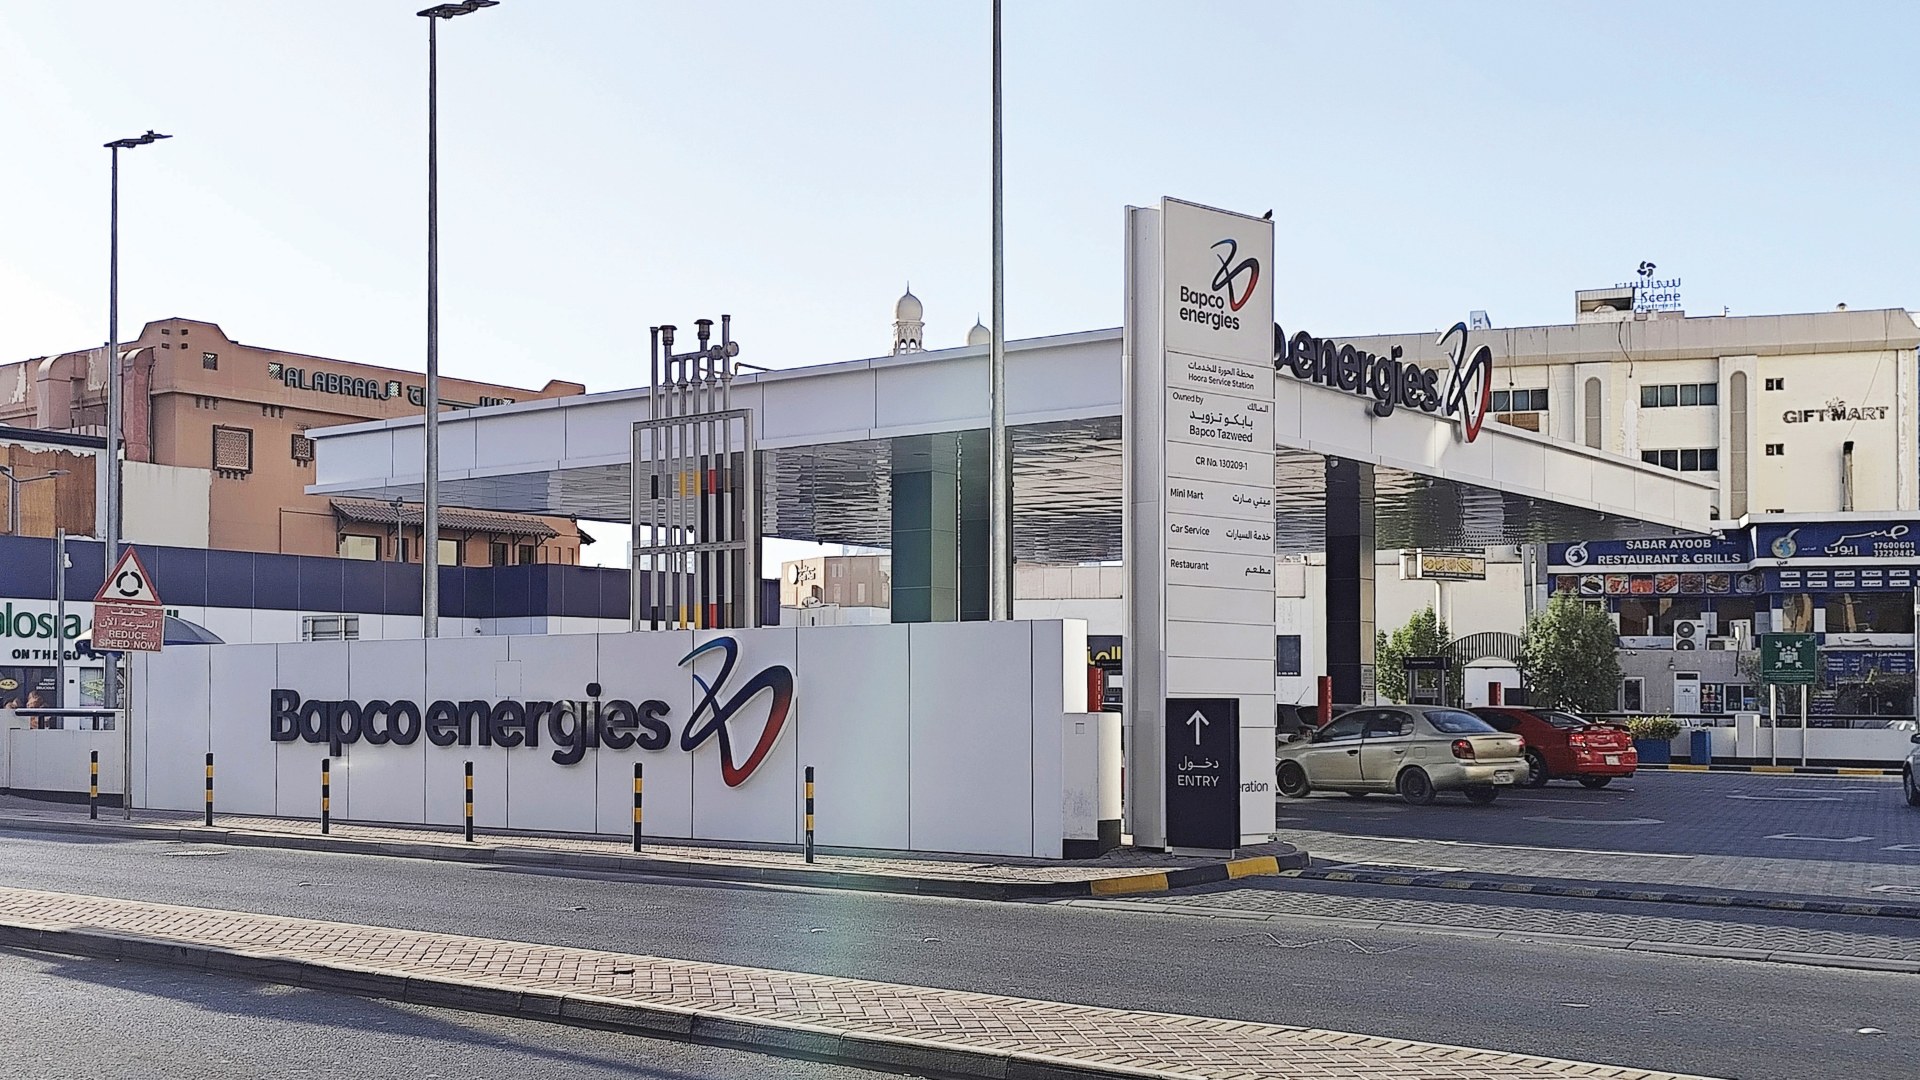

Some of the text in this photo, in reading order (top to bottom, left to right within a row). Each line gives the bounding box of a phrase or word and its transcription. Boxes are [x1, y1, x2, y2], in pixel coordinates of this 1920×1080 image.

[1180, 286, 1224, 309] Bapco
[1180, 307, 1239, 330] energies
[1188, 361, 1217, 373] للخدمات
[1236, 368, 1255, 379] محطة
[1291, 331, 1440, 417] energies
[1188, 373, 1255, 391] Hoora Service Station
[1172, 391, 1204, 405] Owned by
[1782, 406, 1889, 423] GIFT MART
[1224, 414, 1254, 429] بابكو
[1189, 425, 1253, 443] Bapco Tazweed
[1195, 456, 1205, 465] CR
[1219, 459, 1248, 470] 130209-1
[1170, 488, 1204, 500] Mini Mart
[1232, 494, 1271, 508] ميني مارت
[1170, 524, 1210, 536] Car Service
[1226, 529, 1271, 541] خدمة السيارات
[1626, 539, 1667, 550] SABAR
[1669, 539, 1712, 549] AYOOB
[1873, 542, 1915, 550] 17600601
[1170, 559, 1209, 570] Restaurant
[1598, 553, 1741, 565] RESTAURANT & GRILLS
[1245, 565, 1271, 576] مطعم
[109, 630, 148, 640] REDUCE
[99, 639, 157, 649] SPEED NOW
[12, 649, 30, 659] ON
[271, 682, 671, 765] Bapco energies
[1178, 755, 1220, 771] دخول
[1177, 775, 1219, 787] ENTRY
[1240, 781, 1268, 792] ration
